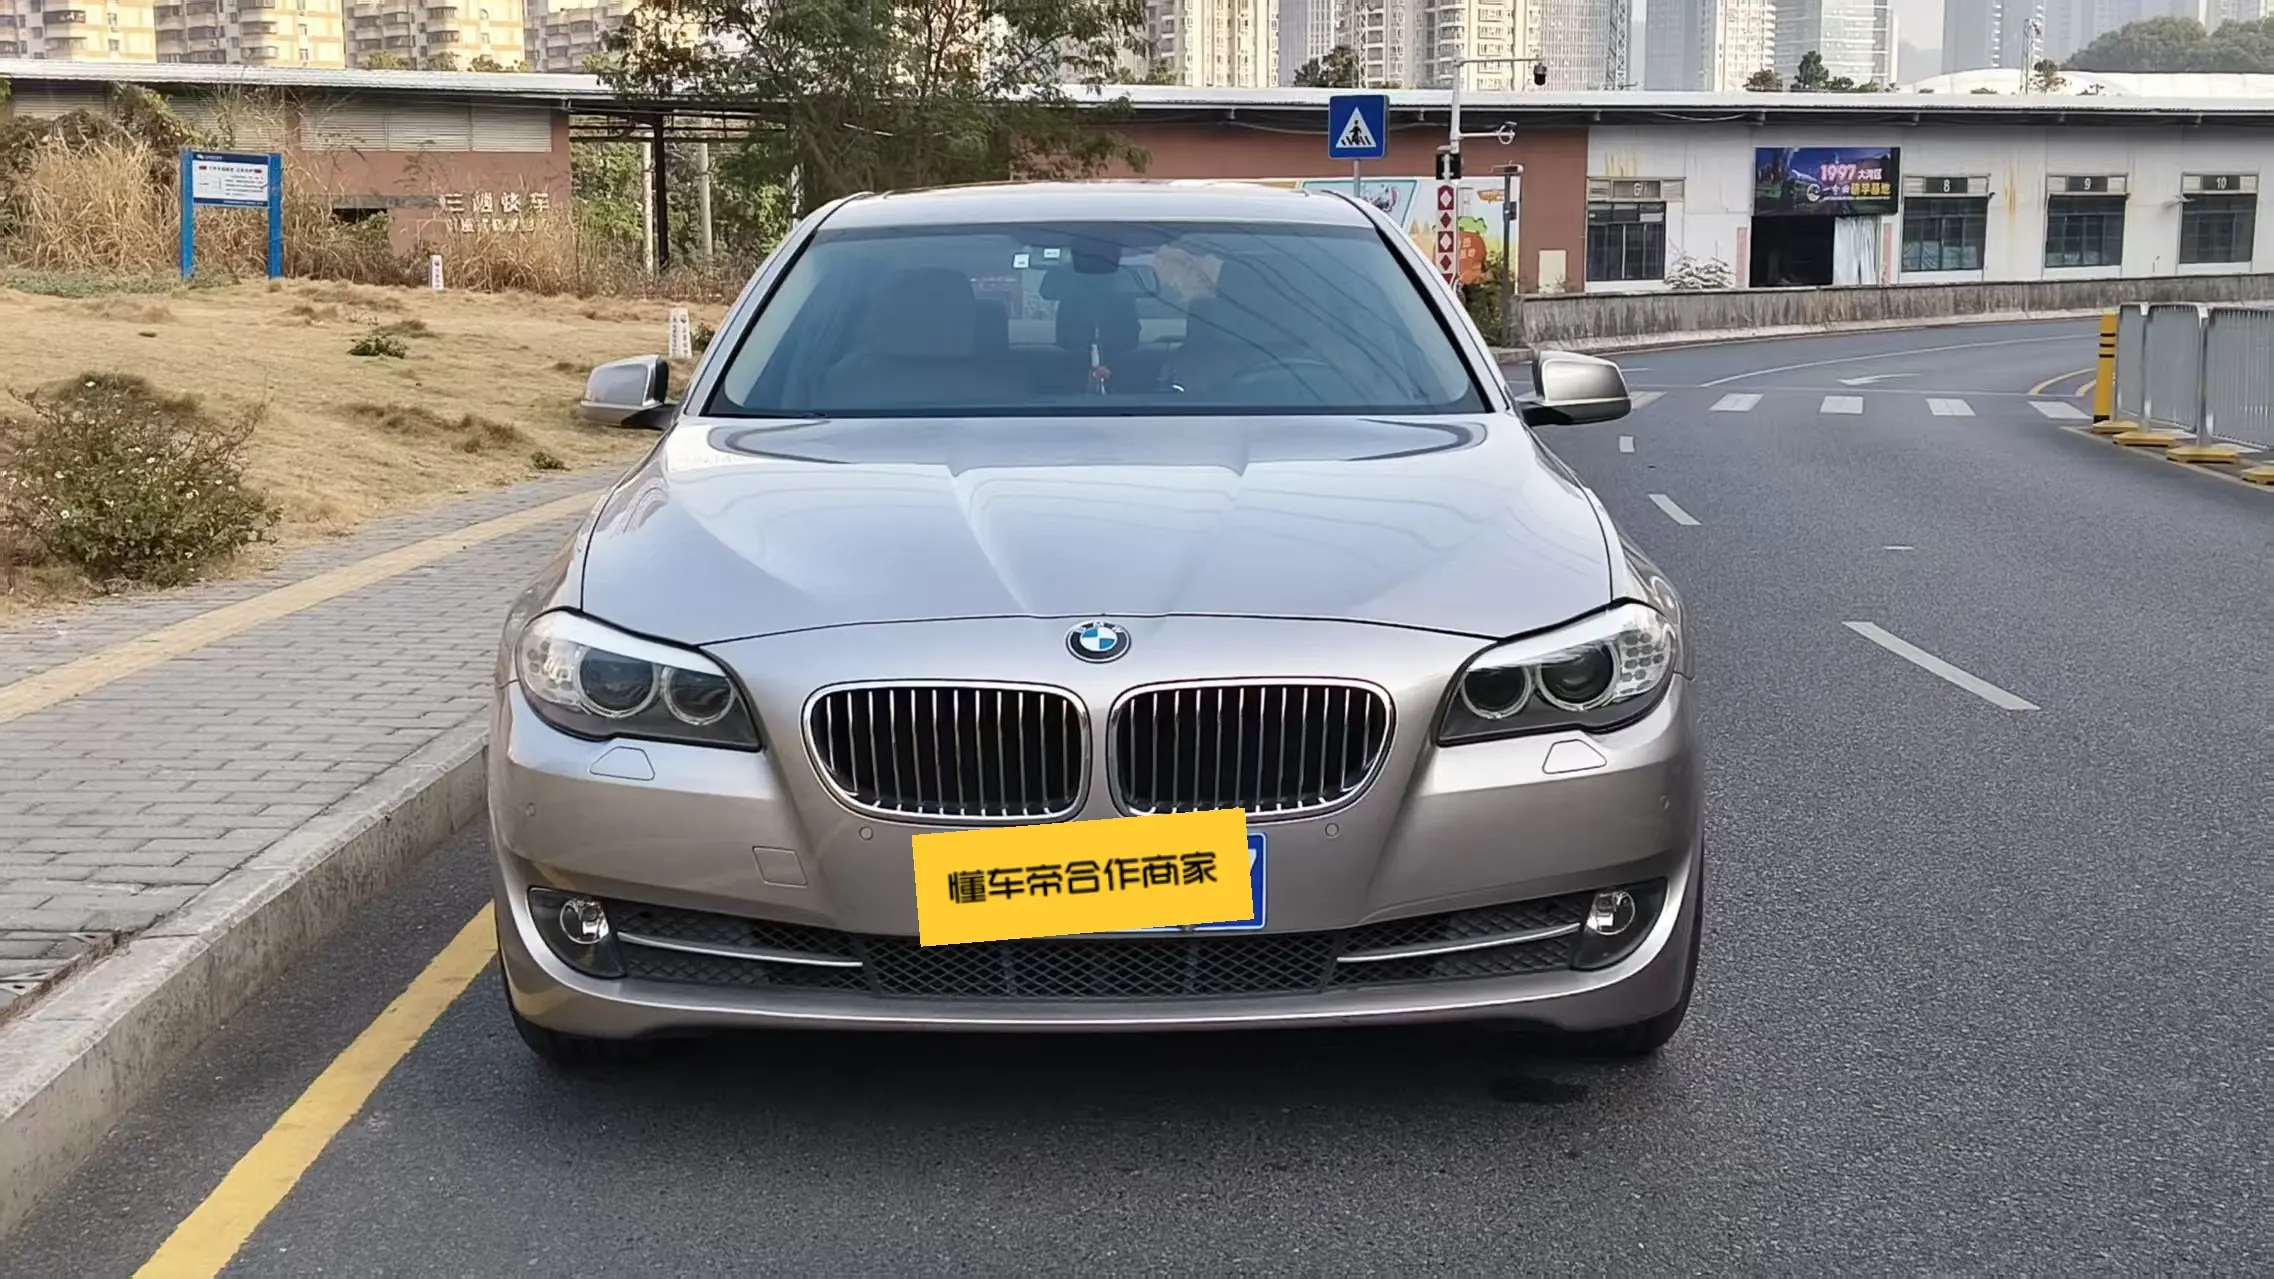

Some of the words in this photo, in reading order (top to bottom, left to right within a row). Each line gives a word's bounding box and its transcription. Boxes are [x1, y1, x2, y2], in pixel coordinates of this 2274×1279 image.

[1820, 164, 1856, 181] 1997
[1943, 179, 1951, 192] 8
[2084, 178, 2092, 190] 9
[2216, 176, 2227, 189] 10
